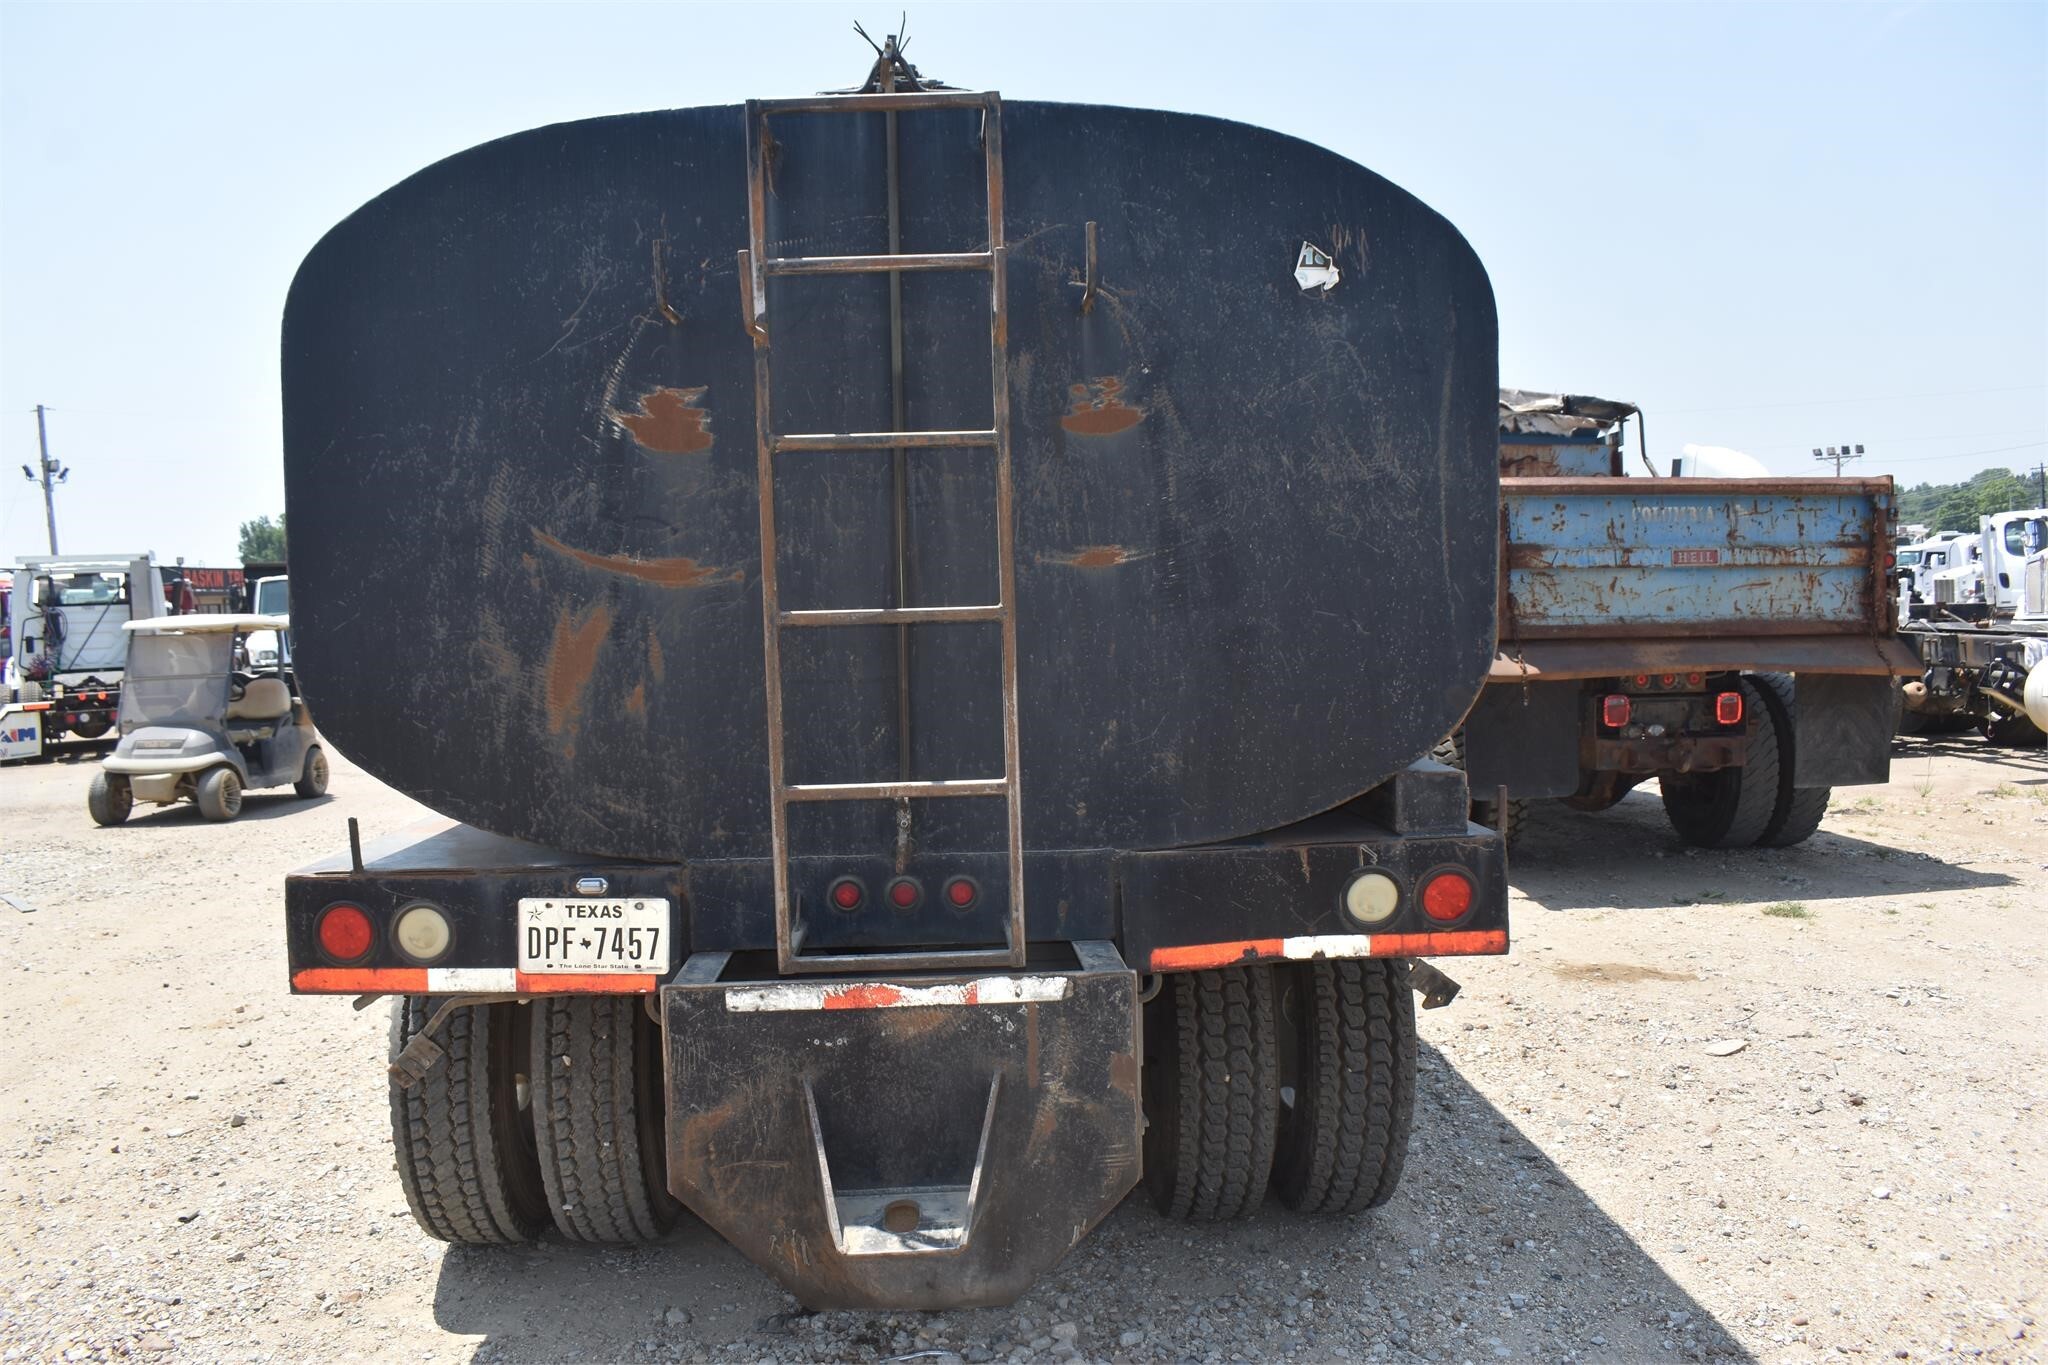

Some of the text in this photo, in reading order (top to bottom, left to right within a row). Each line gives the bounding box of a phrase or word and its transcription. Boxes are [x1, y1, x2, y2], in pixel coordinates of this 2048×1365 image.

[1677, 551, 1714, 563] HEIL
[565, 905, 623, 919] TEXAS
[527, 926, 660, 960] DPF 7457
